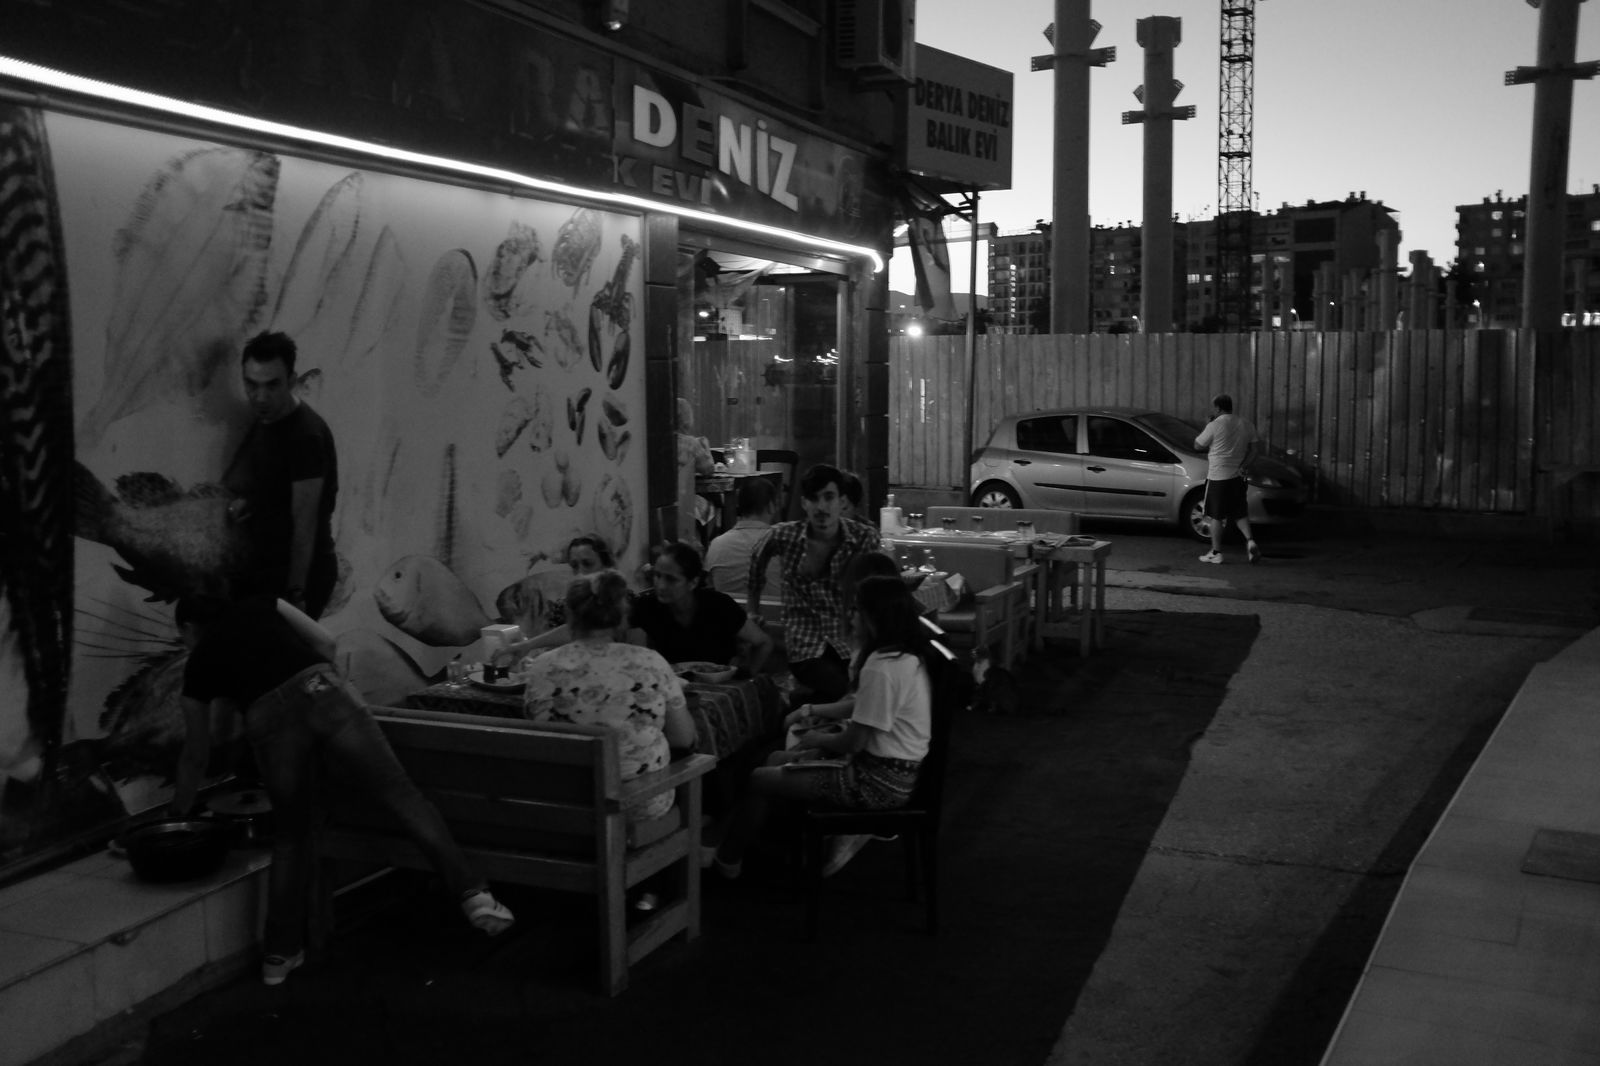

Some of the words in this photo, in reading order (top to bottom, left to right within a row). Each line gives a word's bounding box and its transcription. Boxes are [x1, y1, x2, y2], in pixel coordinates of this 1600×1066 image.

[915, 77, 963, 117] DERYA
[633, 84, 799, 213] DENİZ
[926, 118, 971, 156] BALIK
